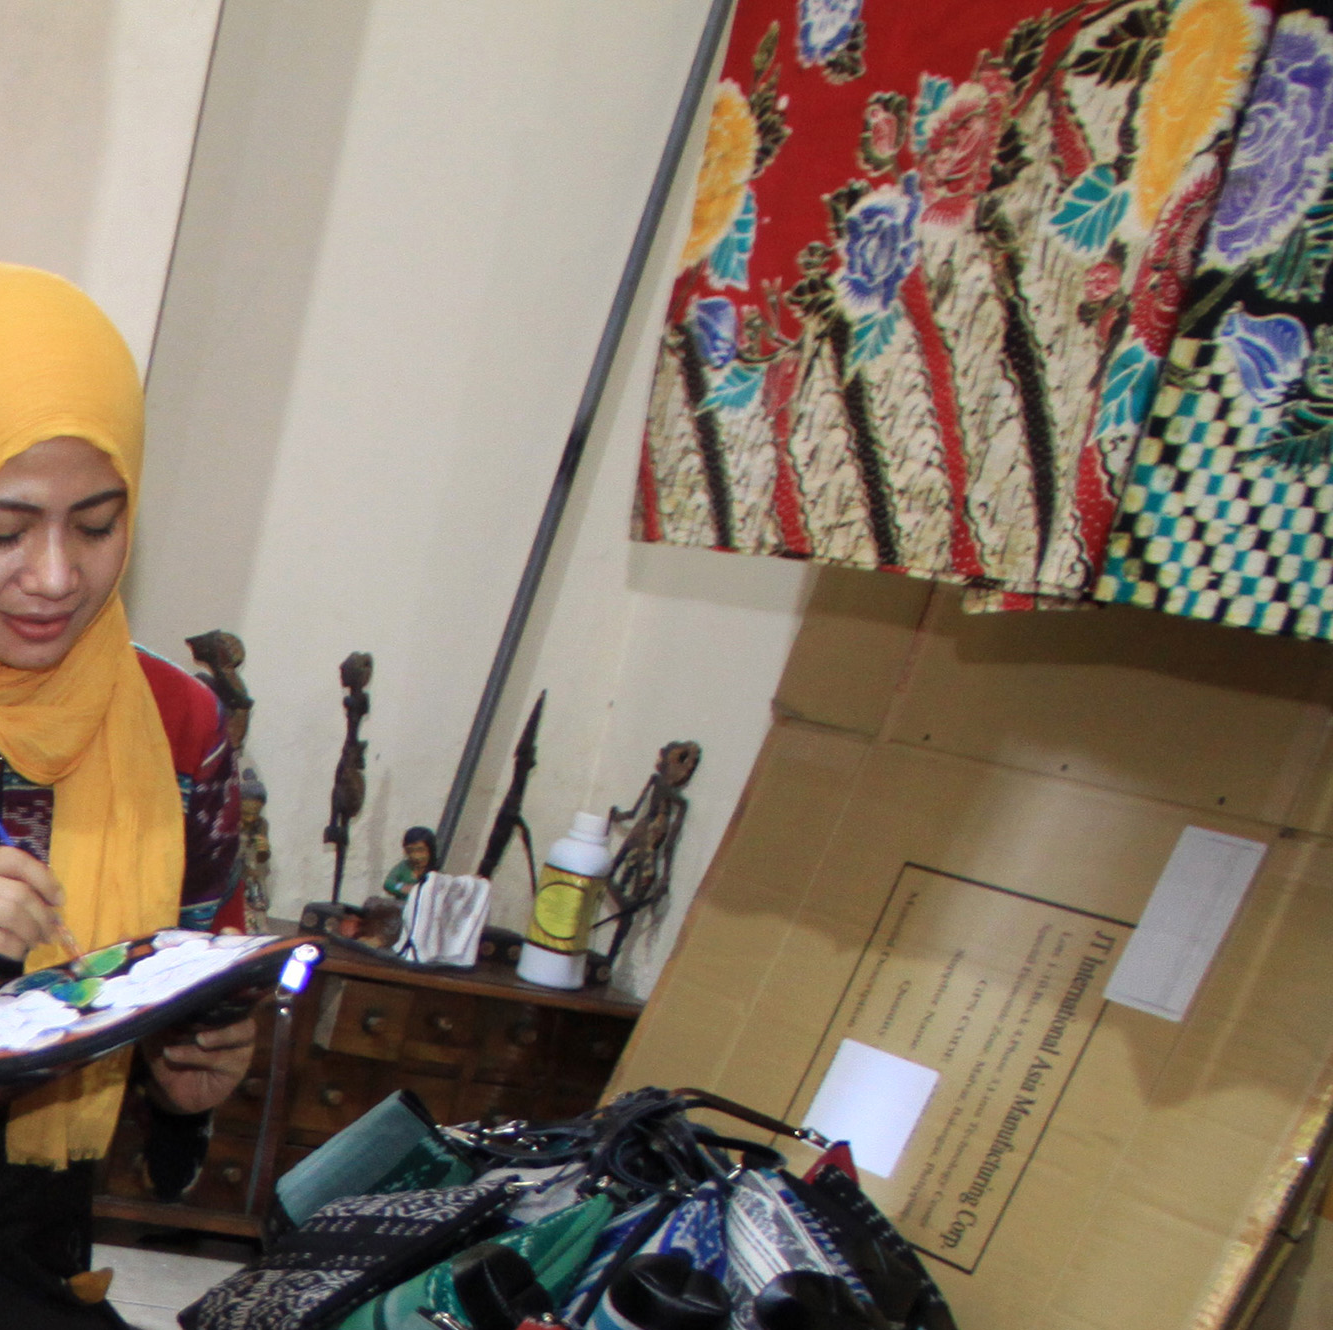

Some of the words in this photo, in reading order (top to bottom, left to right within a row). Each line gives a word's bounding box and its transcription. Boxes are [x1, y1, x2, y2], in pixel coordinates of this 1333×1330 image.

[1088, 929, 1117, 954] JT
[1037, 954, 1106, 1057] International
[1020, 1056, 1054, 1094] Asia
[956, 1091, 1036, 1212] Manufacturing
[937, 1207, 977, 1254] Corp.
